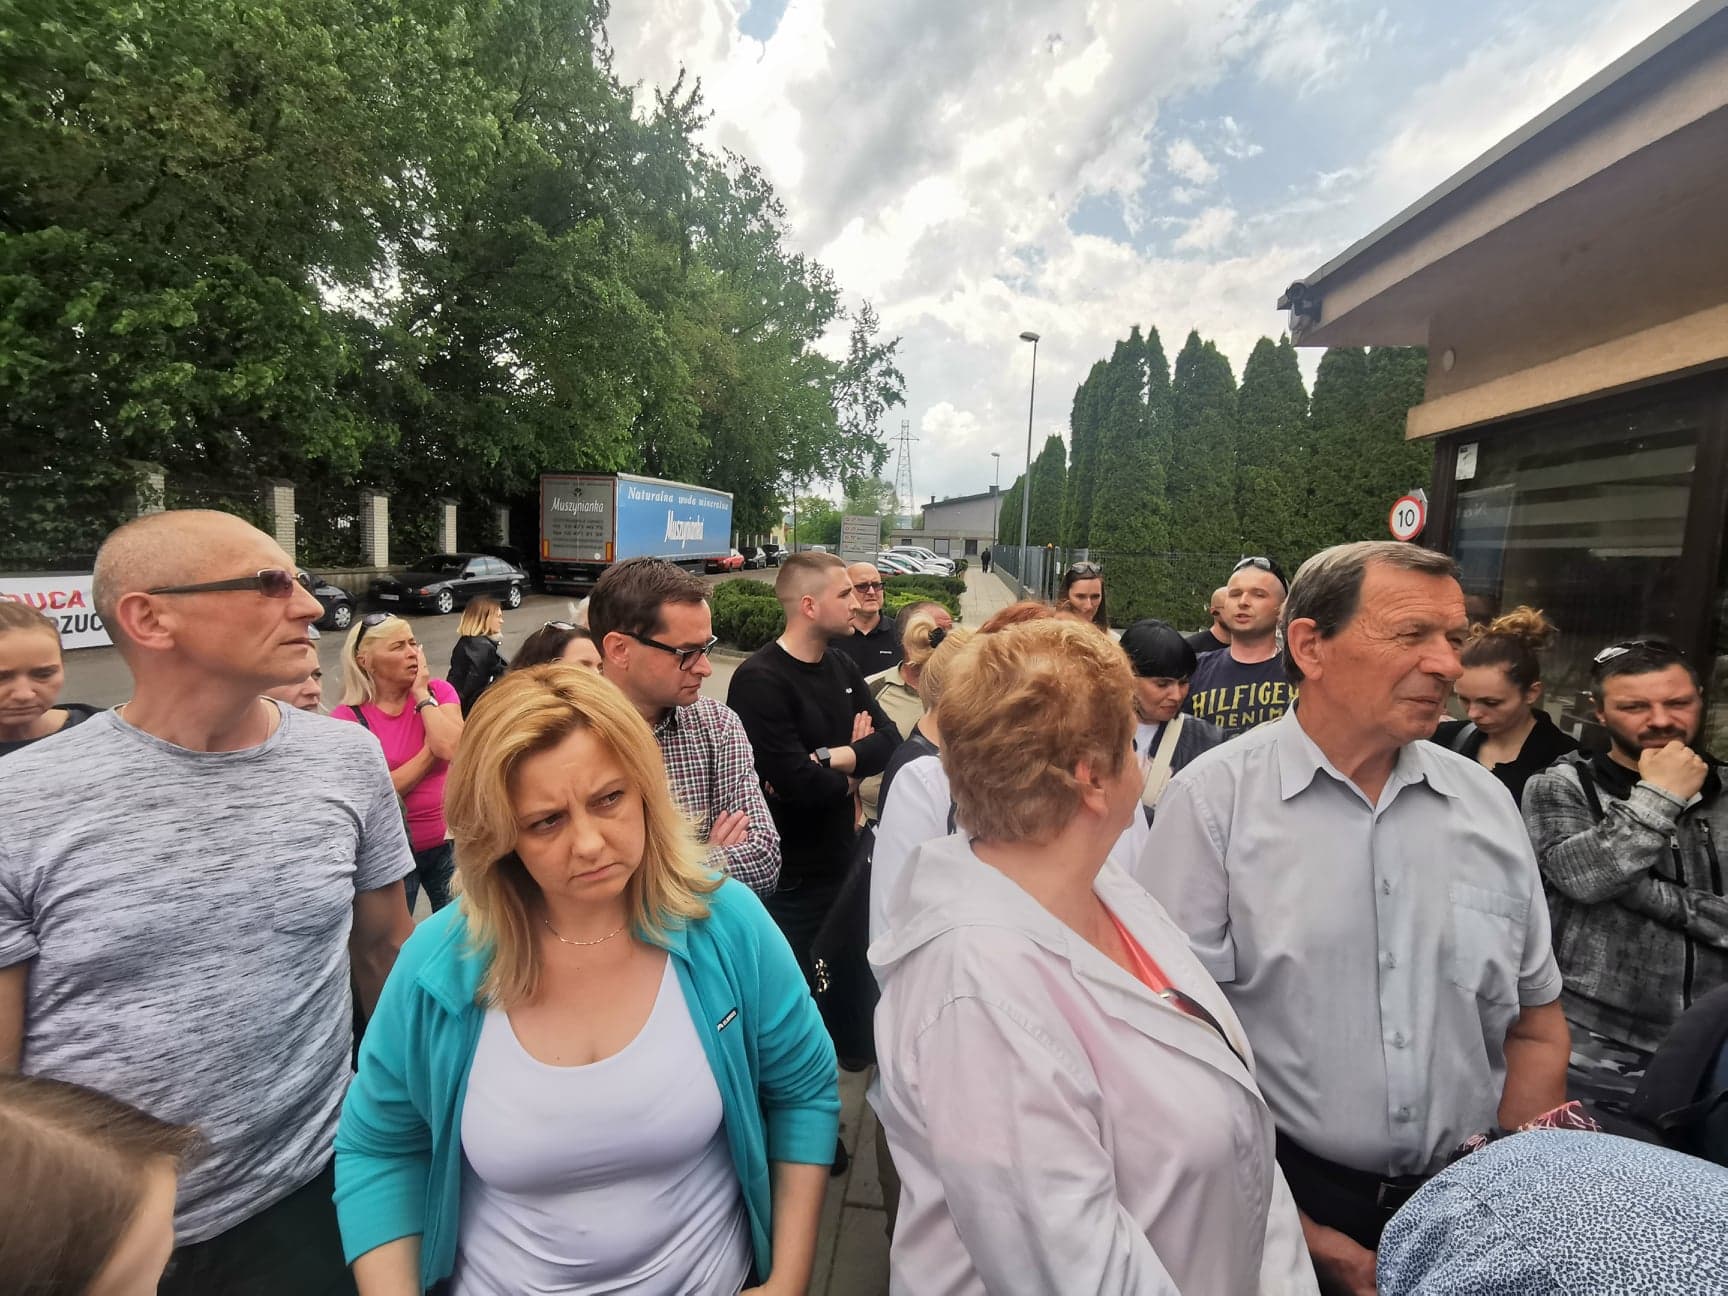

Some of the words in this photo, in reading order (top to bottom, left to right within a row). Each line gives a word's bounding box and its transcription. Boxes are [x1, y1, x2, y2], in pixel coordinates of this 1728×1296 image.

[628, 487, 673, 502] Naturalna
[551, 497, 604, 515] Muszynianka
[1399, 509, 1415, 527] 10
[52, 613, 103, 634] ZUC
[1216, 707, 1283, 727] DENIM
